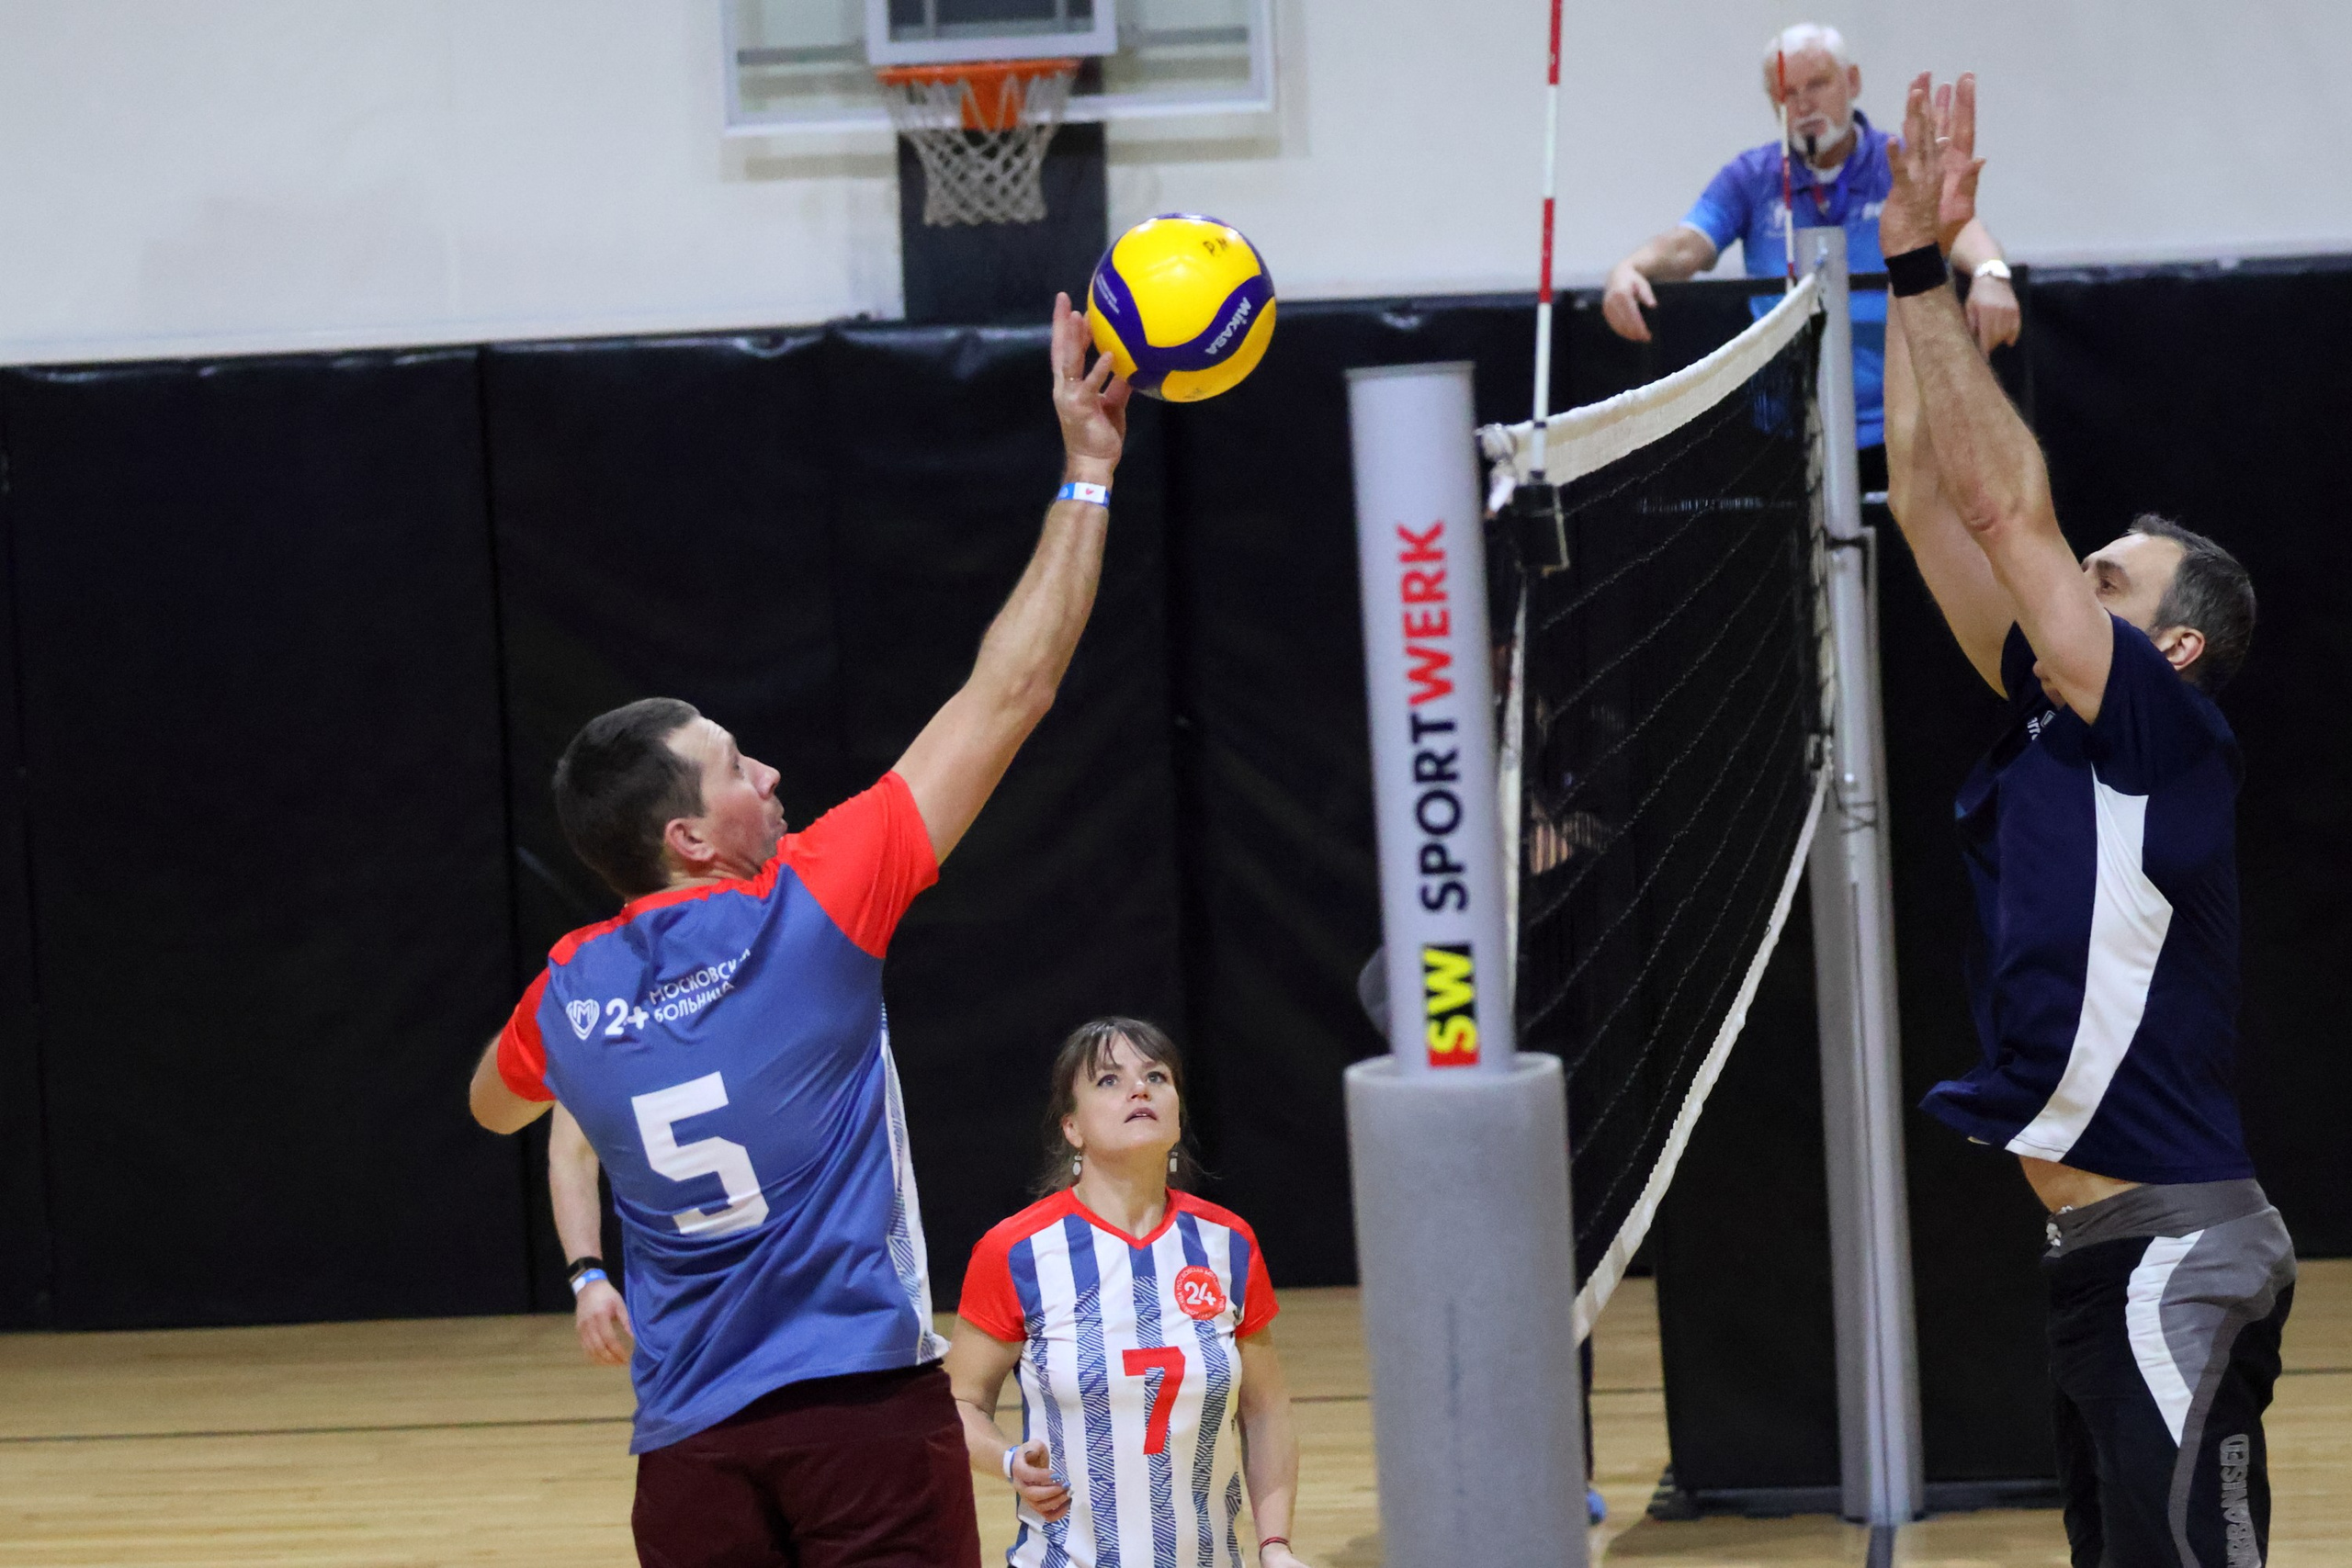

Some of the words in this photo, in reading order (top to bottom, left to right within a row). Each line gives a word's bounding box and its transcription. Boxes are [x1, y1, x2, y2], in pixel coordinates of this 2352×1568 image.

[1396, 520, 1468, 913] SPORTWERK
[1424, 949, 1476, 1053] SW
[631, 1071, 769, 1236] 5
[1184, 1280, 1217, 1306] 24
[1122, 1347, 1185, 1455] 7
